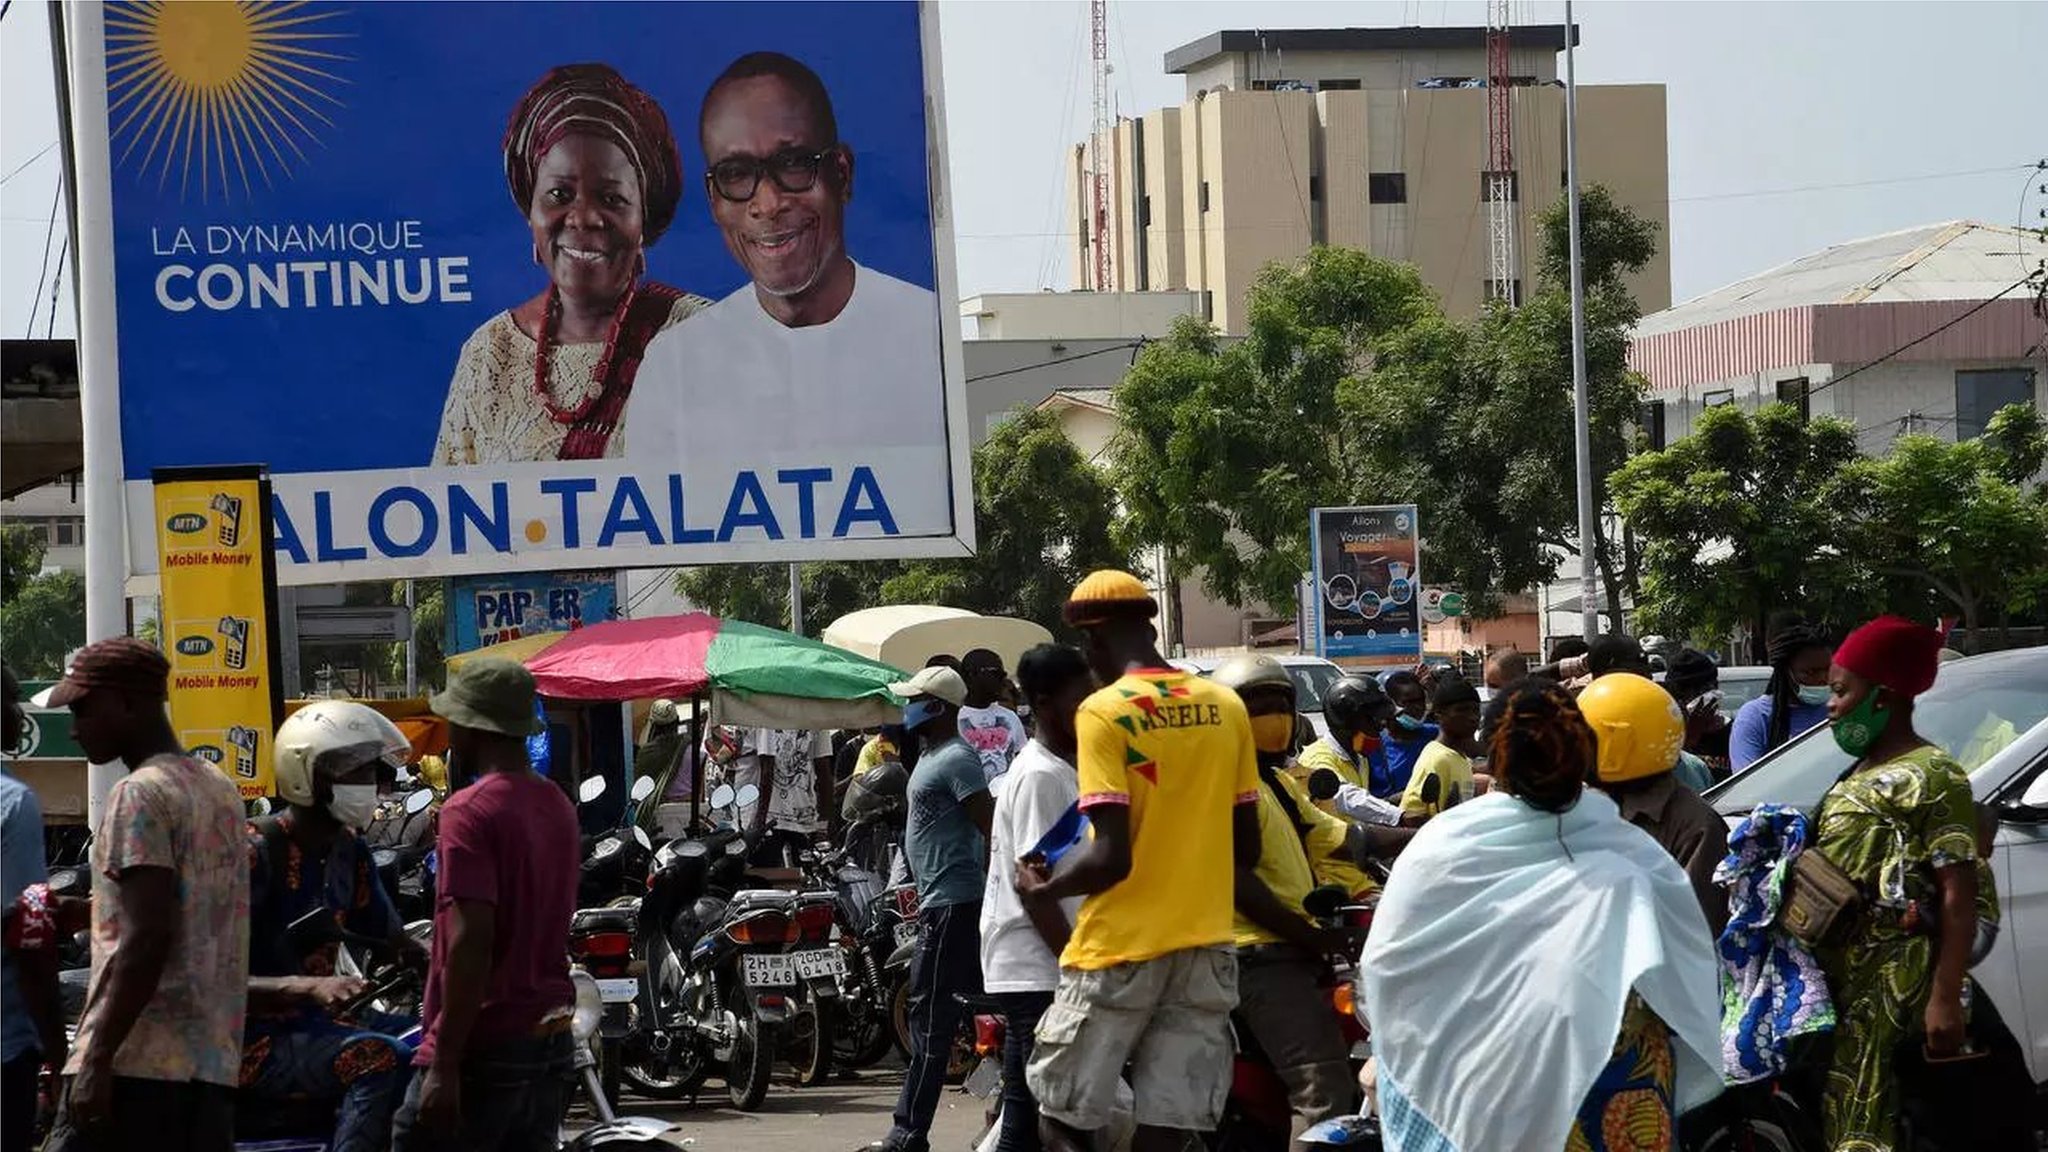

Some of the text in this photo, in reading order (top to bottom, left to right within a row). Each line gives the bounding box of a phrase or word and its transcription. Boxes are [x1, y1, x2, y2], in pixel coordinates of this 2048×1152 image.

[152, 221, 423, 256] LA DYNAMIQUE
[155, 257, 472, 311] CONTINUE
[174, 517, 200, 529] MTN
[271, 466, 899, 564] ALON TALATA
[166, 552, 252, 567] Mobile Money
[184, 640, 207, 652] MTN
[175, 674, 259, 690] Mobile Money
